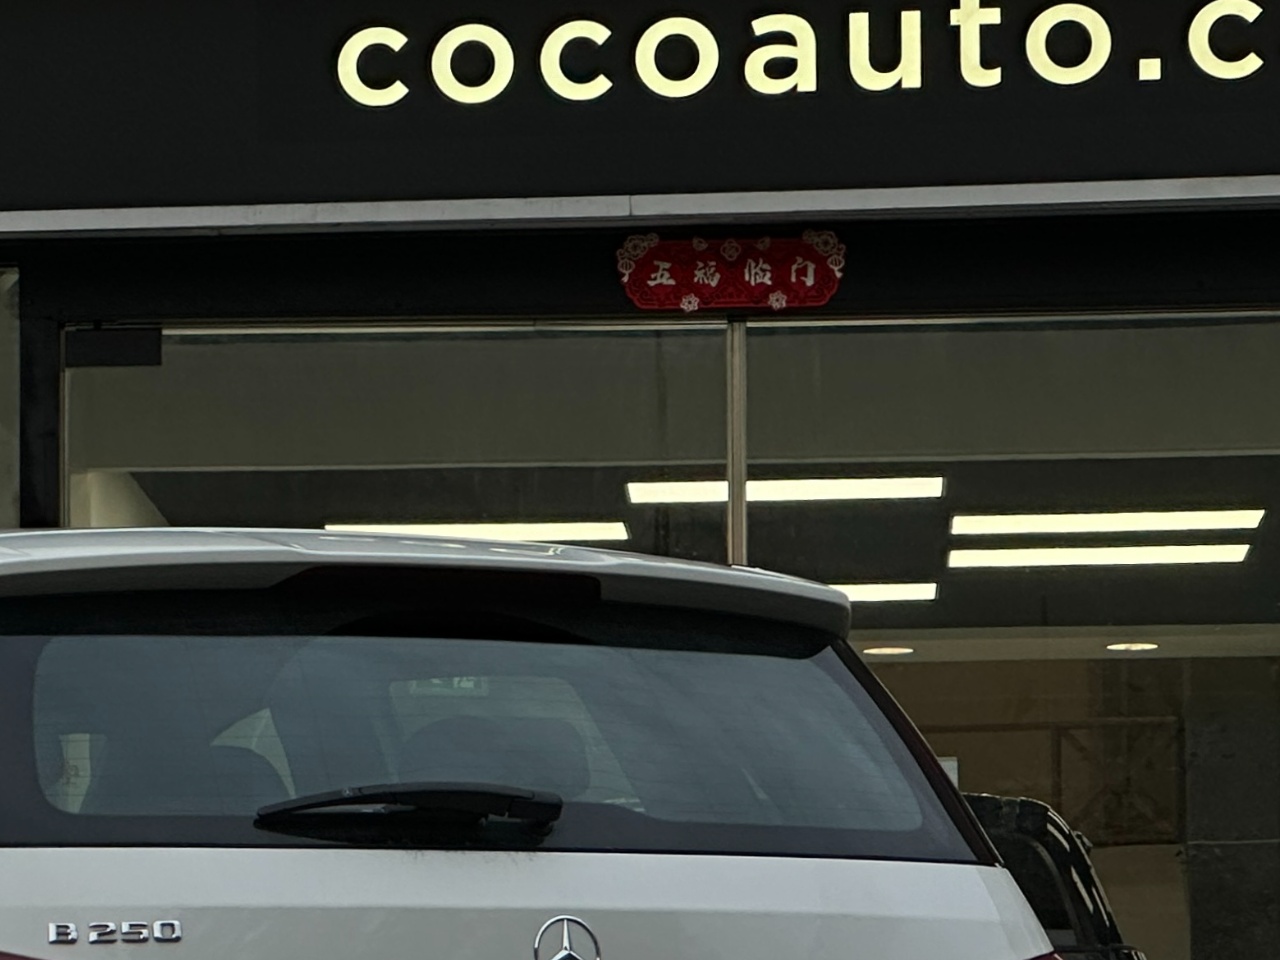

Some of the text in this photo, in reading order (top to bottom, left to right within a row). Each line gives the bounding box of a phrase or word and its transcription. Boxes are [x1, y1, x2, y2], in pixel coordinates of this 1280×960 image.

[337, 0, 1264, 107] cocoauto.c
[646, 256, 816, 287] 五福临门
[48, 920, 182, 945] B 250
